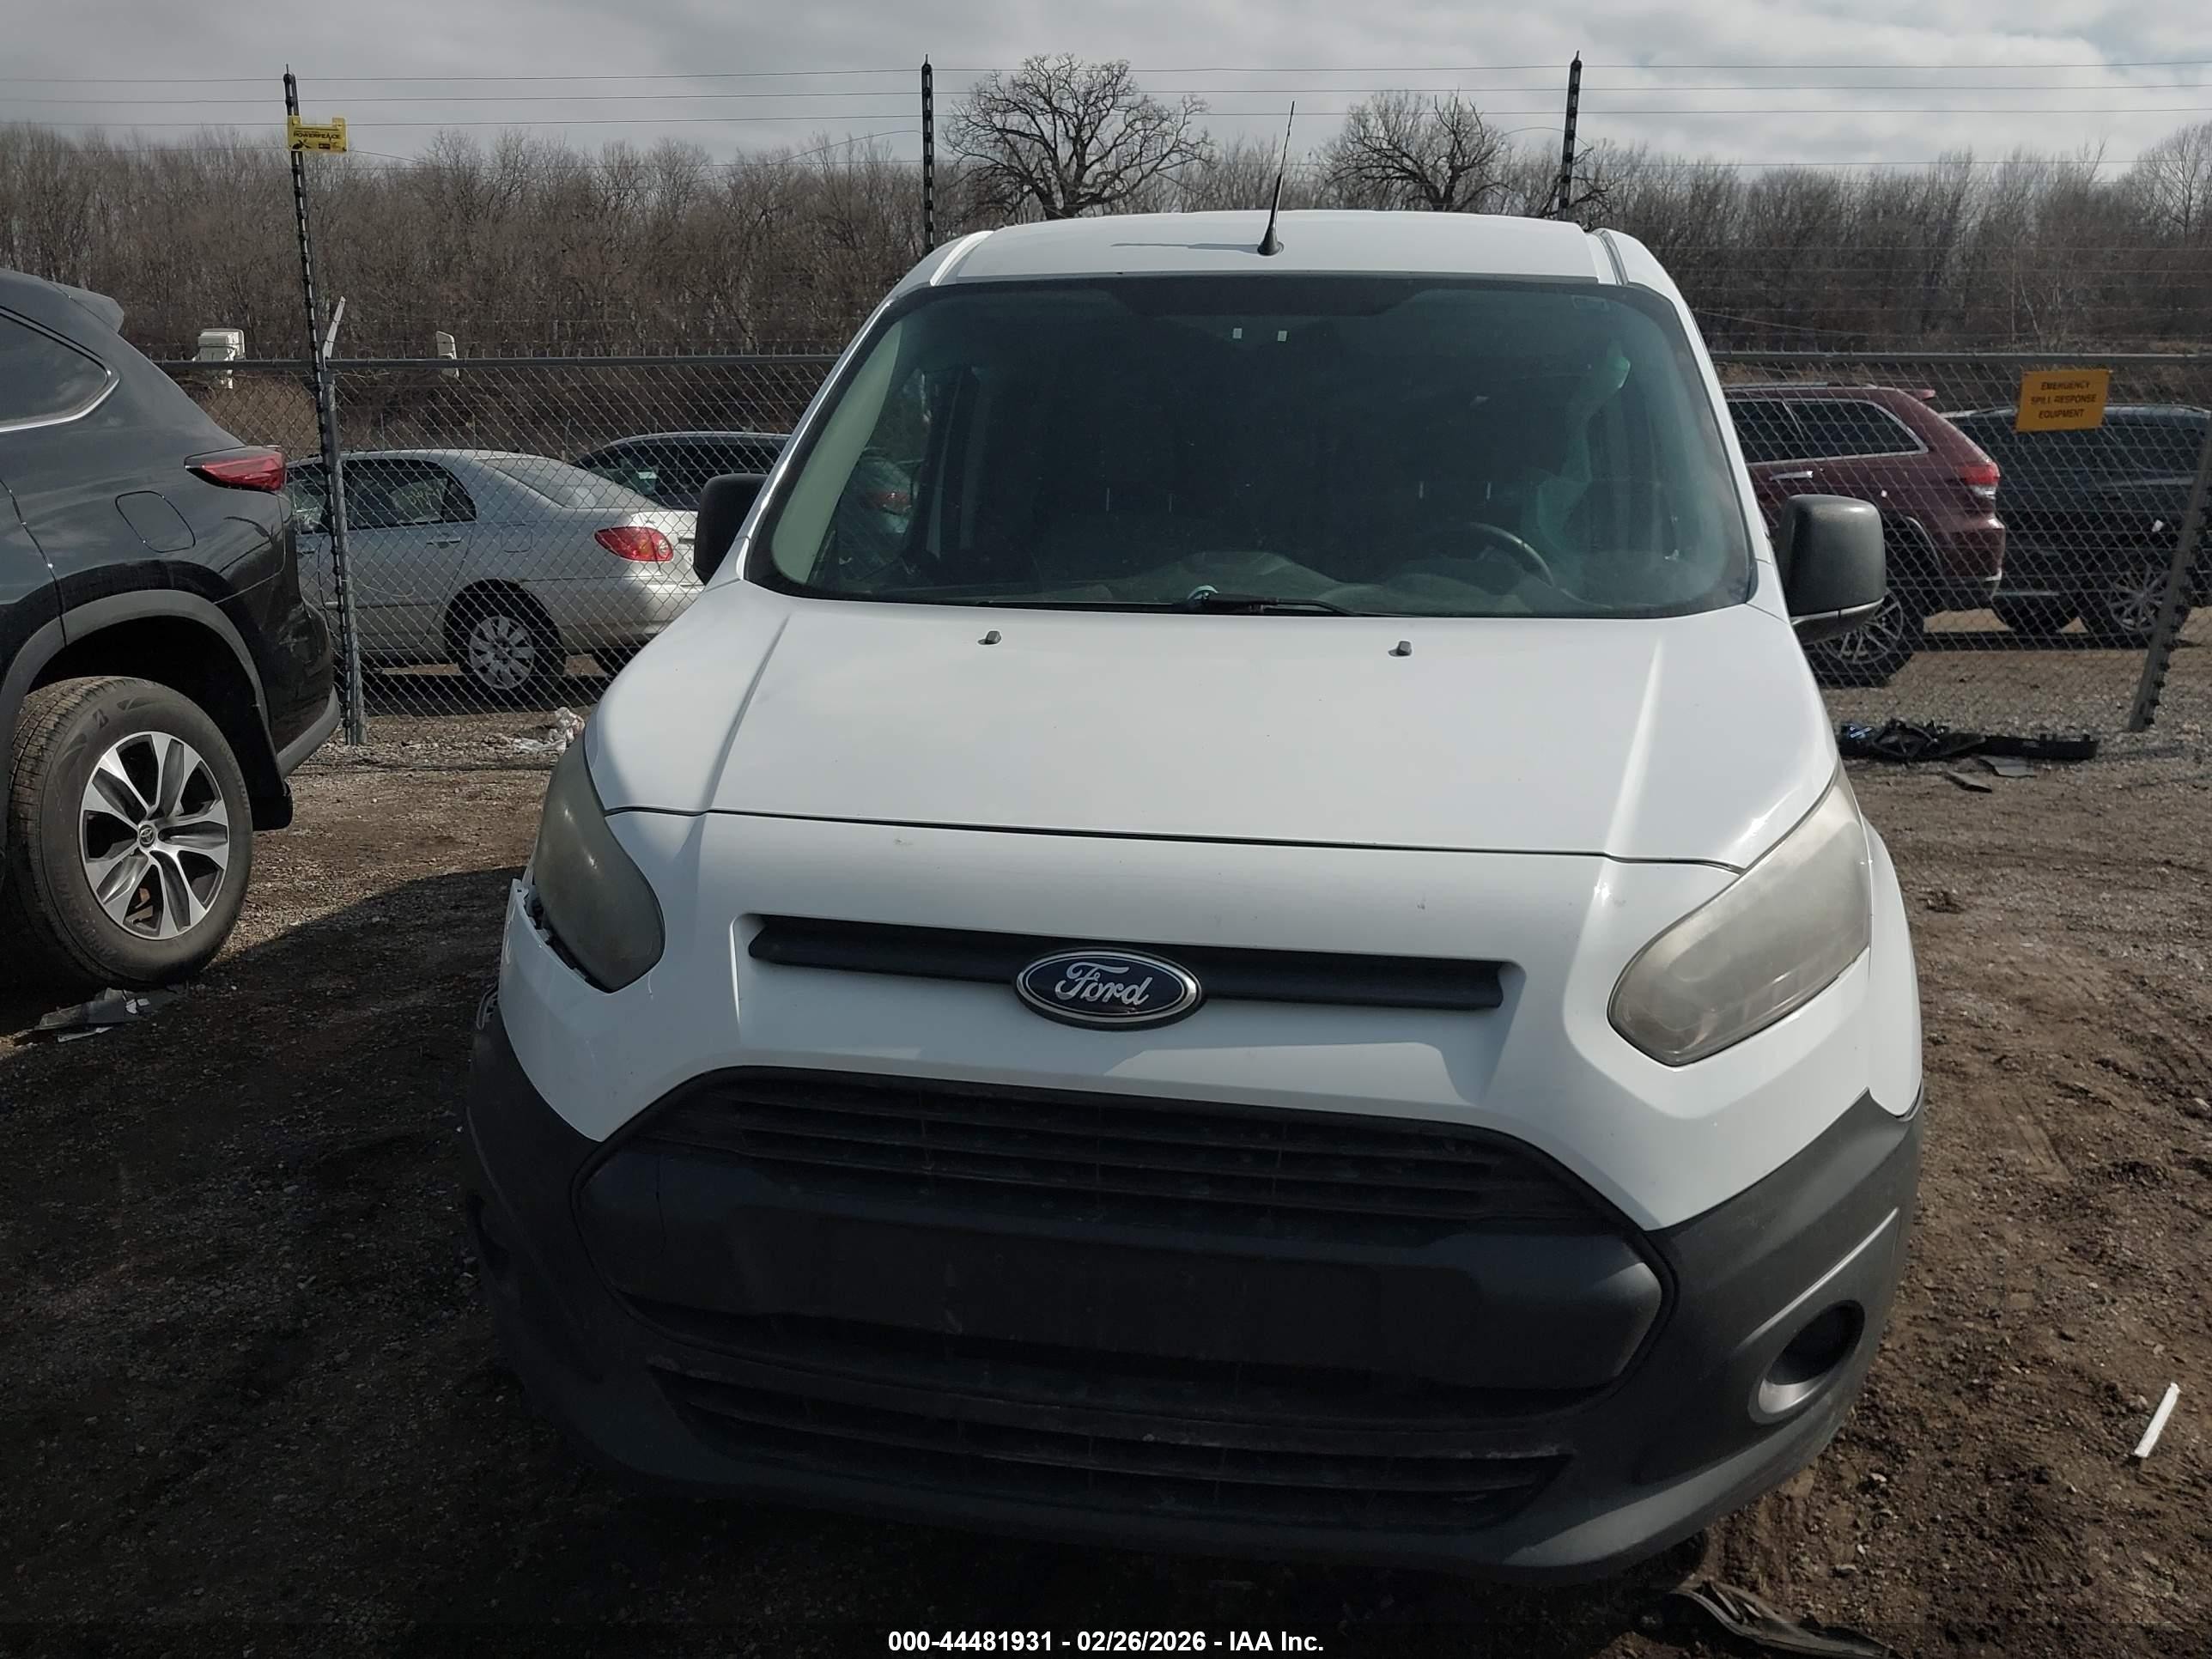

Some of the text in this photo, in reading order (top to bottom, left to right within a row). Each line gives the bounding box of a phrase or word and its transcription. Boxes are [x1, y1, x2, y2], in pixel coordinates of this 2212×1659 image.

[2040, 380, 2090, 391] EMERGENCY
[2054, 393, 2097, 404] RESPONSE
[2039, 408, 2085, 419] EQUIPMENT
[1054, 962, 1154, 1006] Ford
